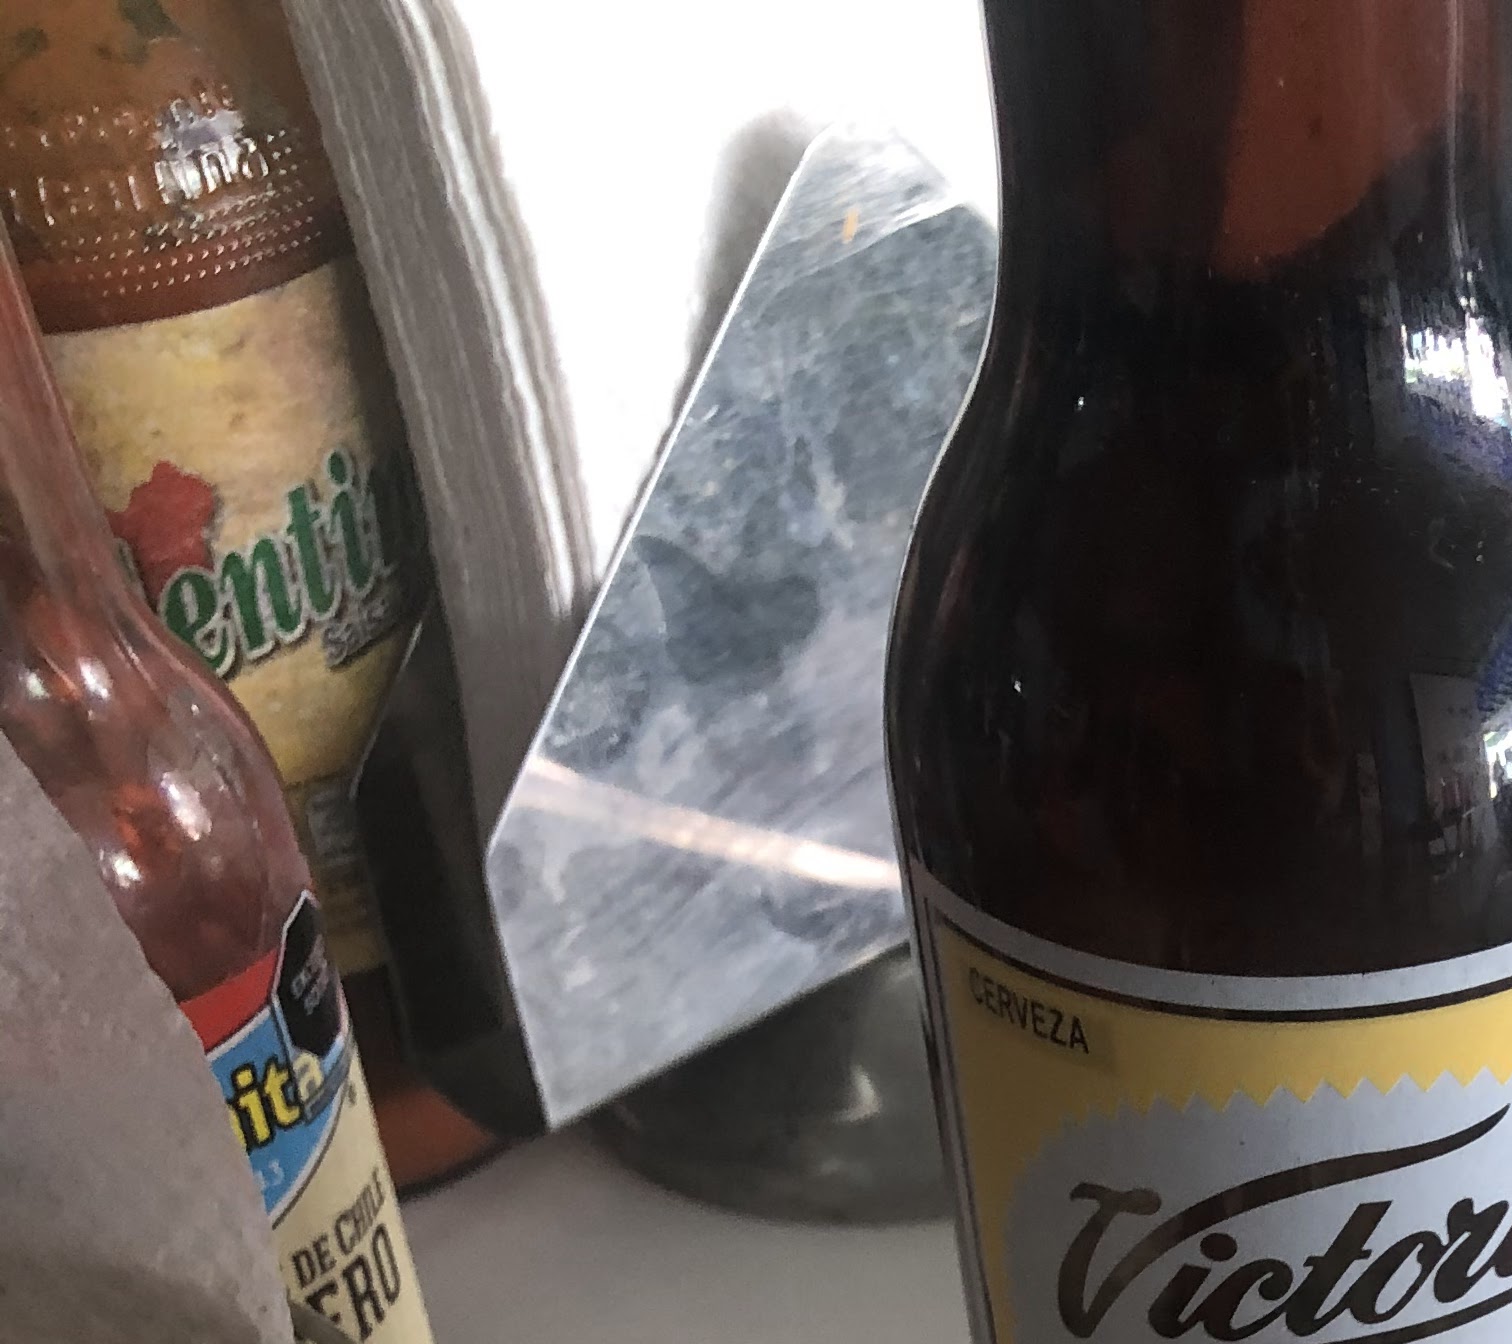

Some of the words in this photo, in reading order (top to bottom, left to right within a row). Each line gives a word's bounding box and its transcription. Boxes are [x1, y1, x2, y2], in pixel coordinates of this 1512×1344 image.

[968, 966, 1090, 1055] CERVEZA
[226, 1050, 325, 1150] ita
[291, 1232, 338, 1289] DE
